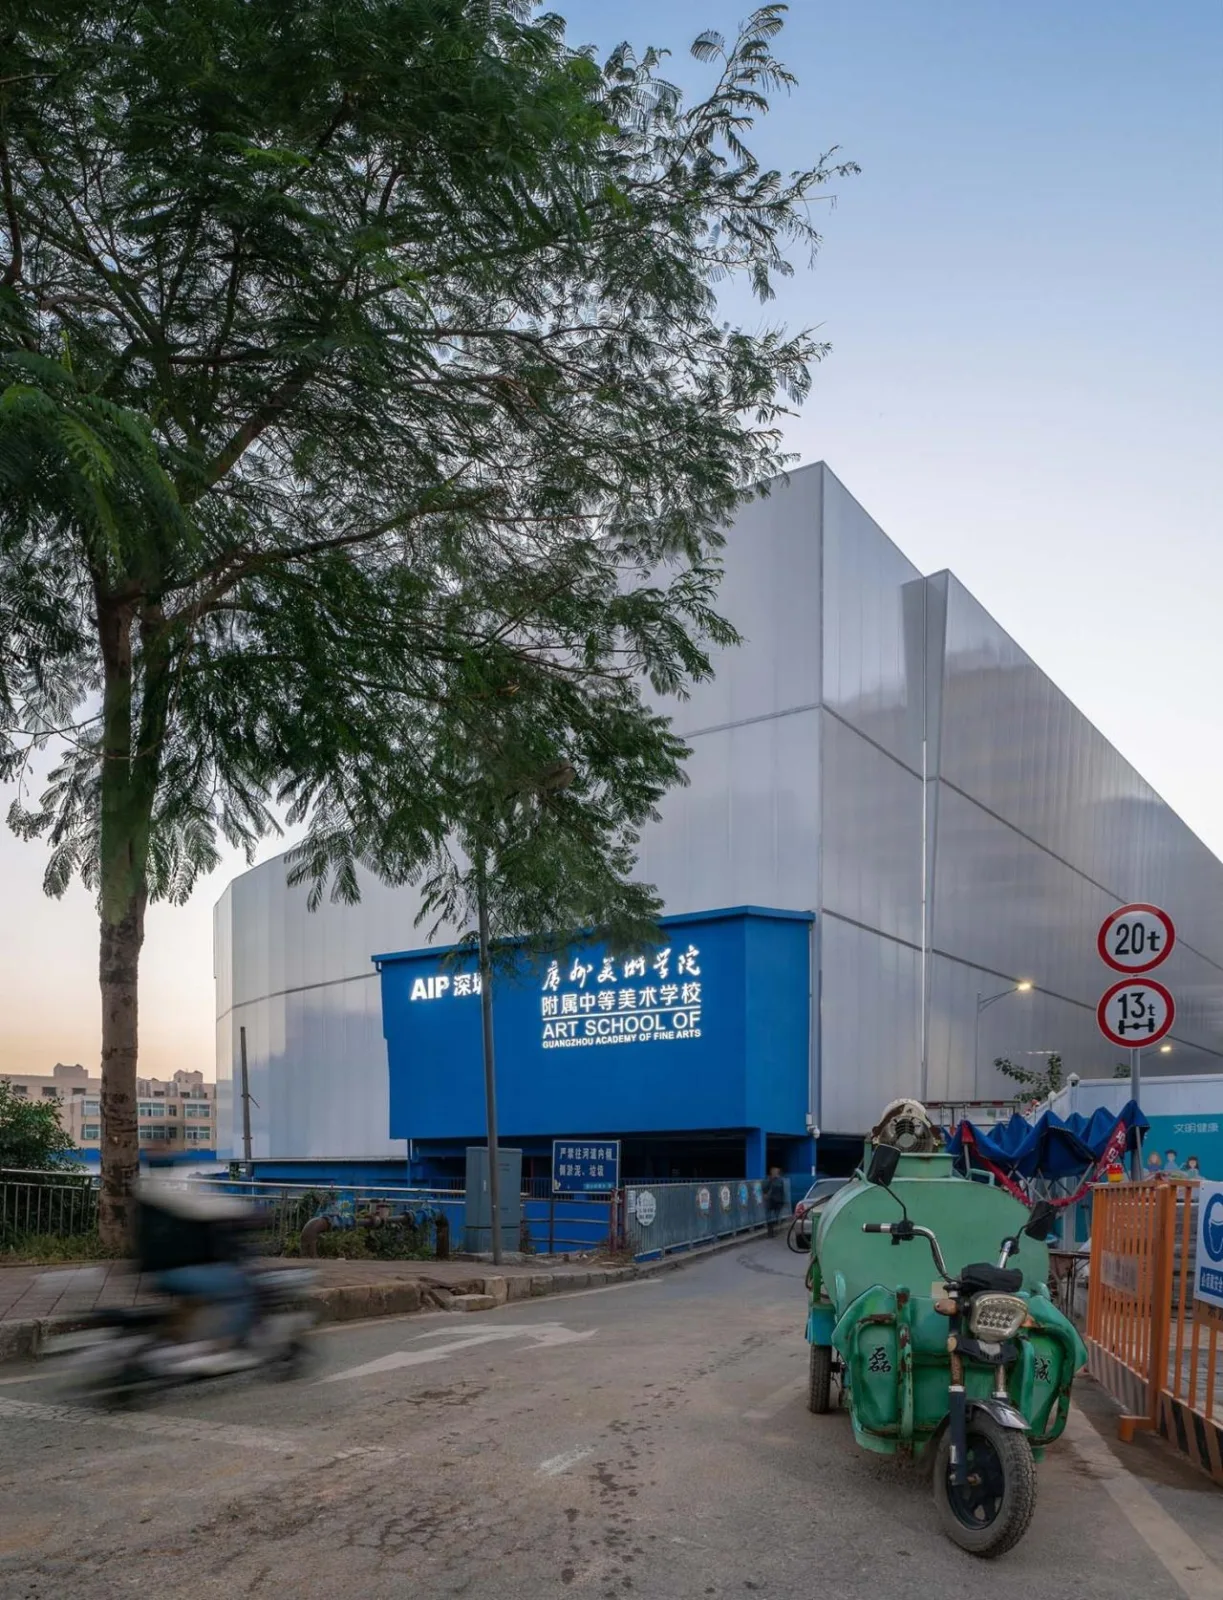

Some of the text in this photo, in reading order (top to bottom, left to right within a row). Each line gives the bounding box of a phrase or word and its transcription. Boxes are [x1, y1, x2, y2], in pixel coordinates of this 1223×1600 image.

[1114, 922, 1160, 955] 20t
[410, 976, 449, 1000] AIP
[542, 982, 701, 1016] 附属中等美术学校
[1117, 992, 1156, 1019] 13t
[542, 1011, 701, 1039] ART SCHOOL OF
[542, 1028, 701, 1048] GUANGZHOU ACADEMY OF FINE ARTS
[1173, 1122, 1219, 1134] 文明健康
